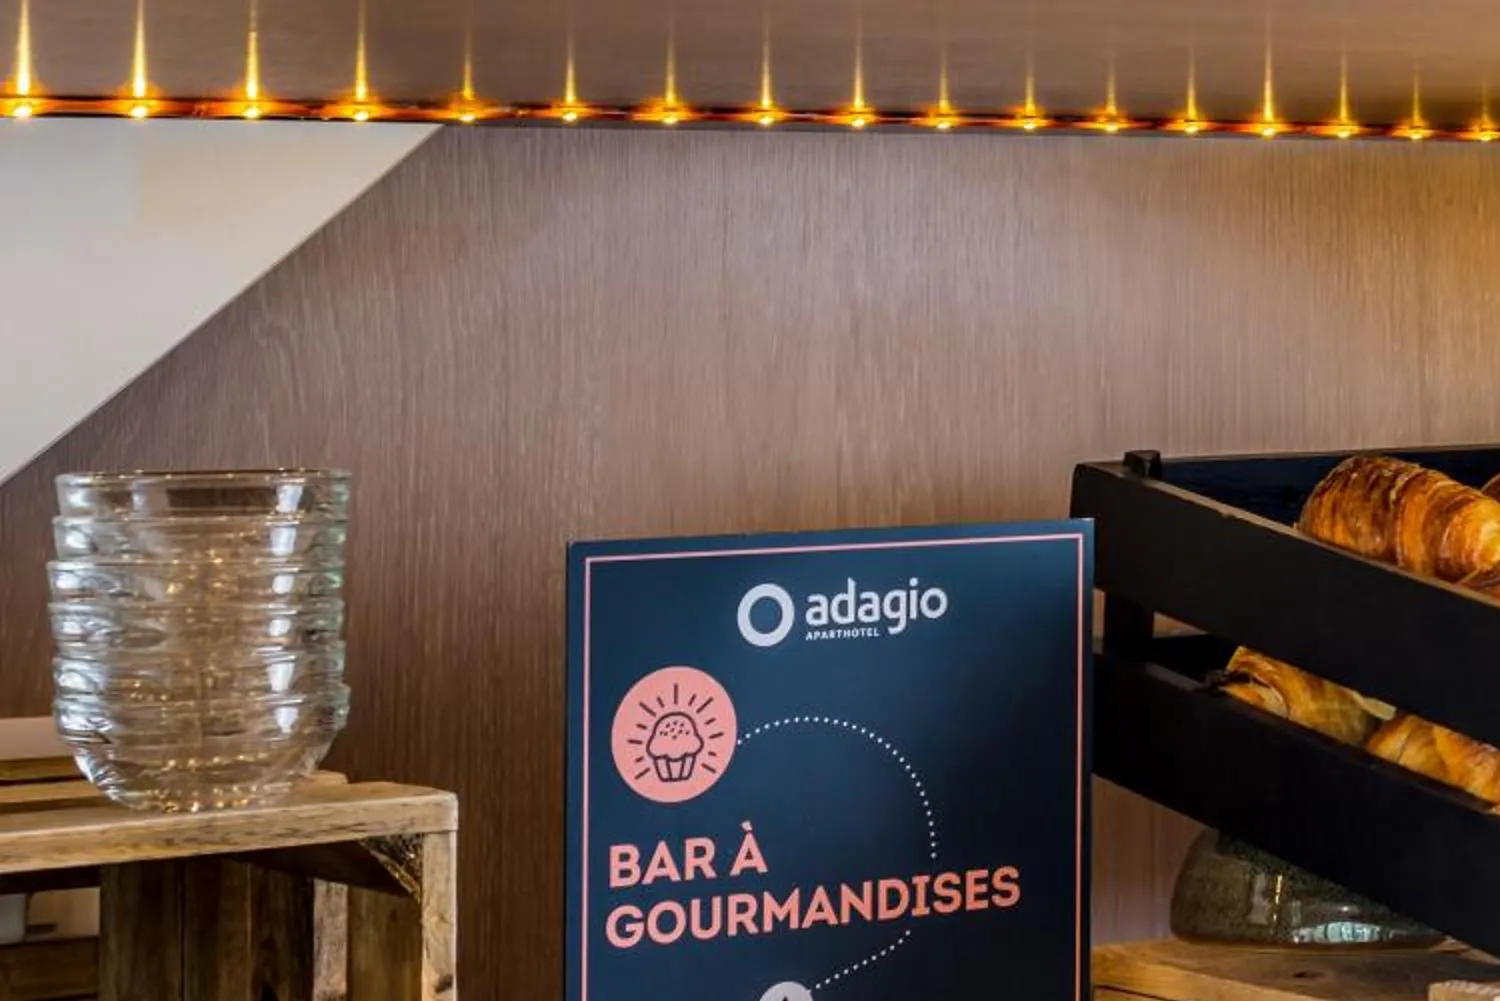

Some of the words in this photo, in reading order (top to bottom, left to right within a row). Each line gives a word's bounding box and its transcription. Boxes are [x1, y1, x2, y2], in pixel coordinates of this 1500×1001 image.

[805, 577, 948, 635] adagio
[805, 626, 880, 641] APARTHOTEL
[608, 837, 717, 888] BAR
[730, 820, 768, 876] À
[605, 865, 1021, 948] GOURMANDISES
